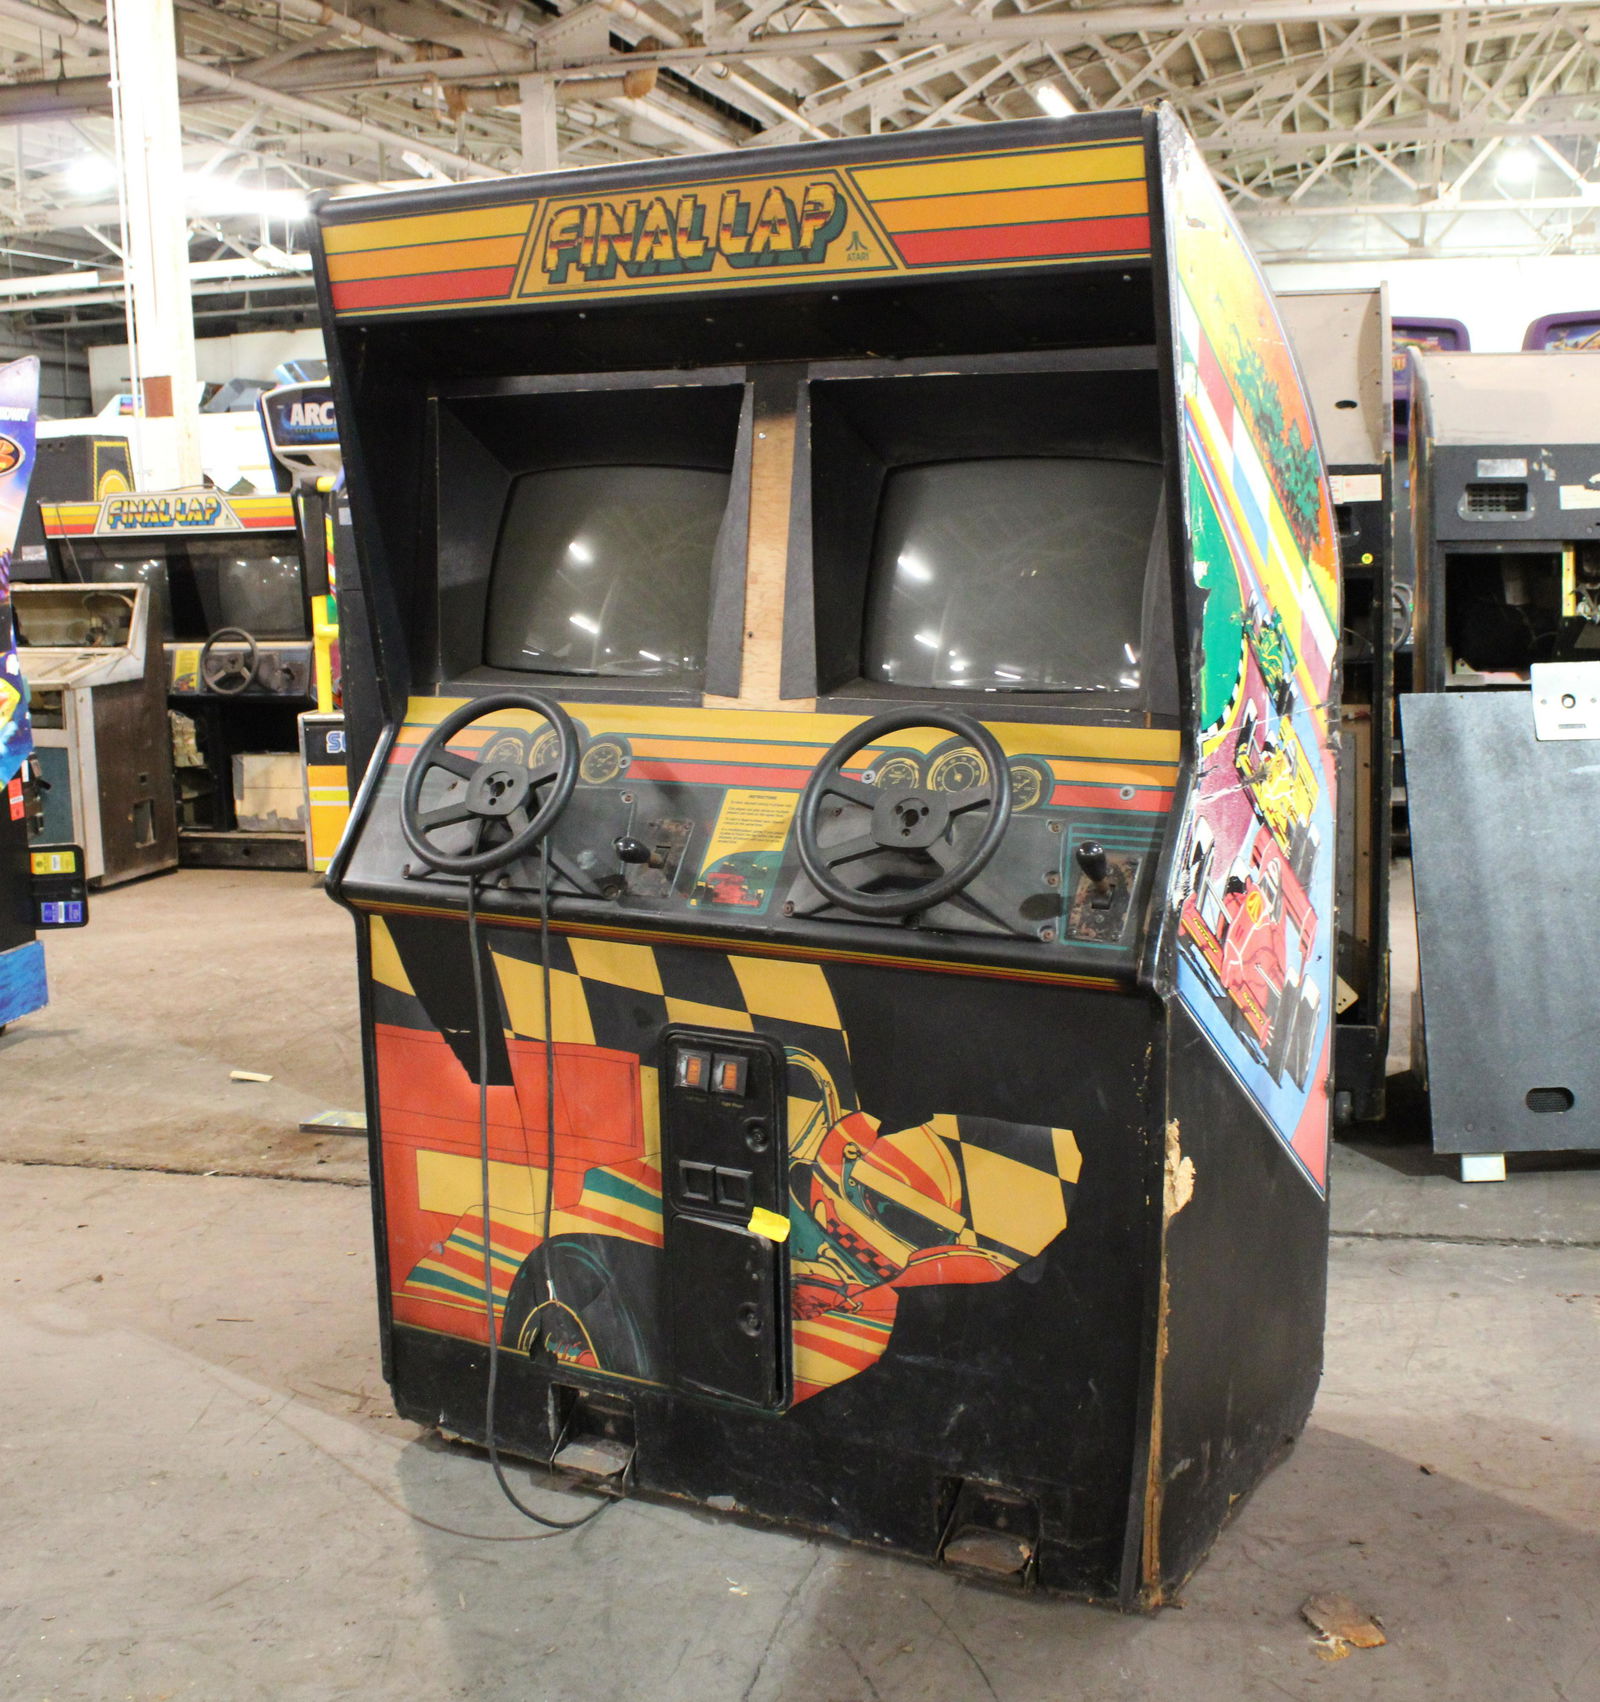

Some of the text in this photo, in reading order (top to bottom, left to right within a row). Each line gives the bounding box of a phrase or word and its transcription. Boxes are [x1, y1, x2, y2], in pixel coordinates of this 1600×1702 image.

[541, 182, 849, 284] FINAL LAP
[291, 401, 337, 426] ARC
[108, 496, 222, 530] FINAL LAP
